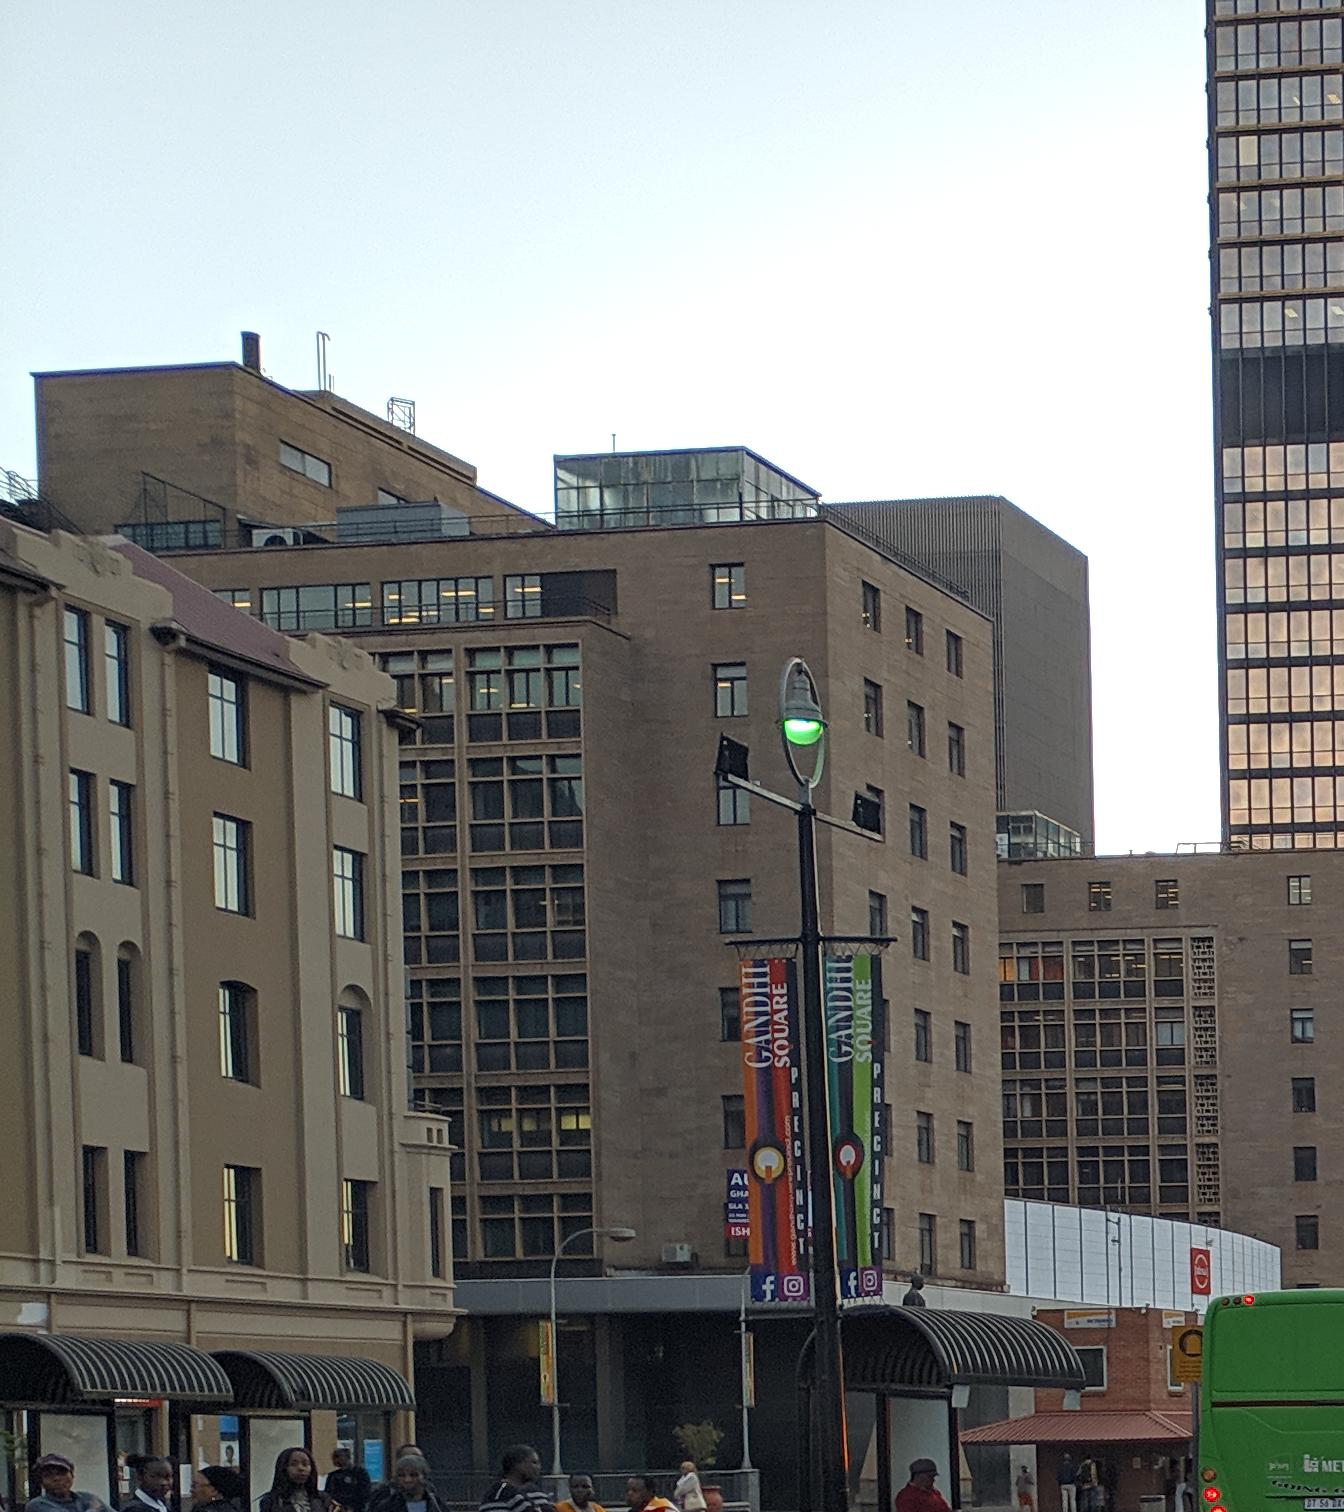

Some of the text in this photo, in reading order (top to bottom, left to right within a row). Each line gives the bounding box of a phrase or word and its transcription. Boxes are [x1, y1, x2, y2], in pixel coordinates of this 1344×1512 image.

[742, 965, 773, 1068] GANDHI
[772, 983, 793, 1068] SQUARE
[826, 962, 854, 1063] GANDHI
[856, 979, 873, 1063] SQUARE
[791, 1067, 805, 1255] PRECINCT
[873, 1063, 881, 1249] PRECINCT
